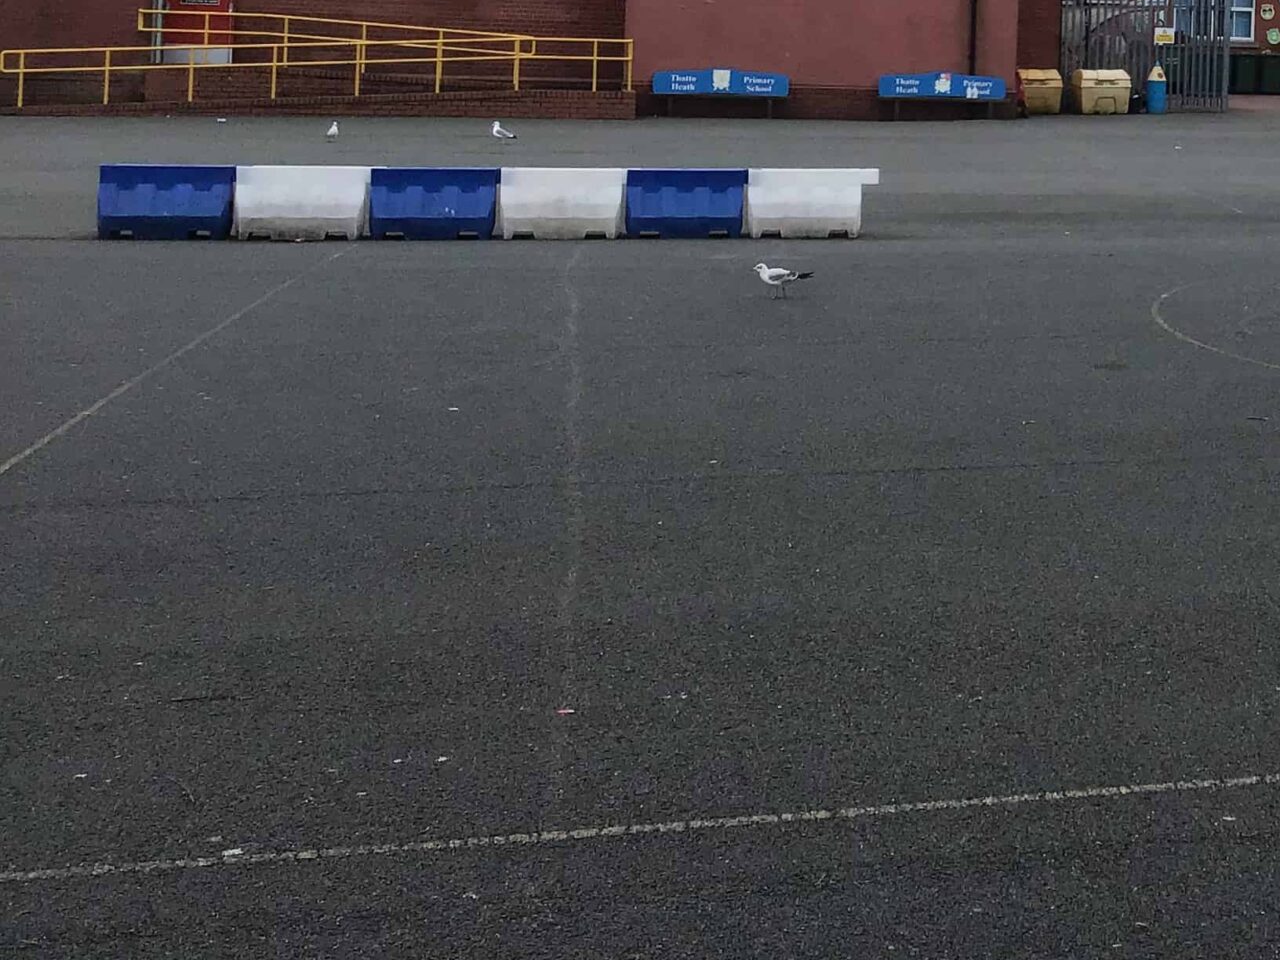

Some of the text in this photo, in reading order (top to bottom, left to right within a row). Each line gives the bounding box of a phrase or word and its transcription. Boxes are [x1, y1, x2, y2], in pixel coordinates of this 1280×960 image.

[671, 74, 697, 82] Thatto
[743, 76, 775, 85] Primary
[671, 83, 696, 91] Heath
[746, 84, 772, 92] School
[895, 86, 919, 94] Heath
